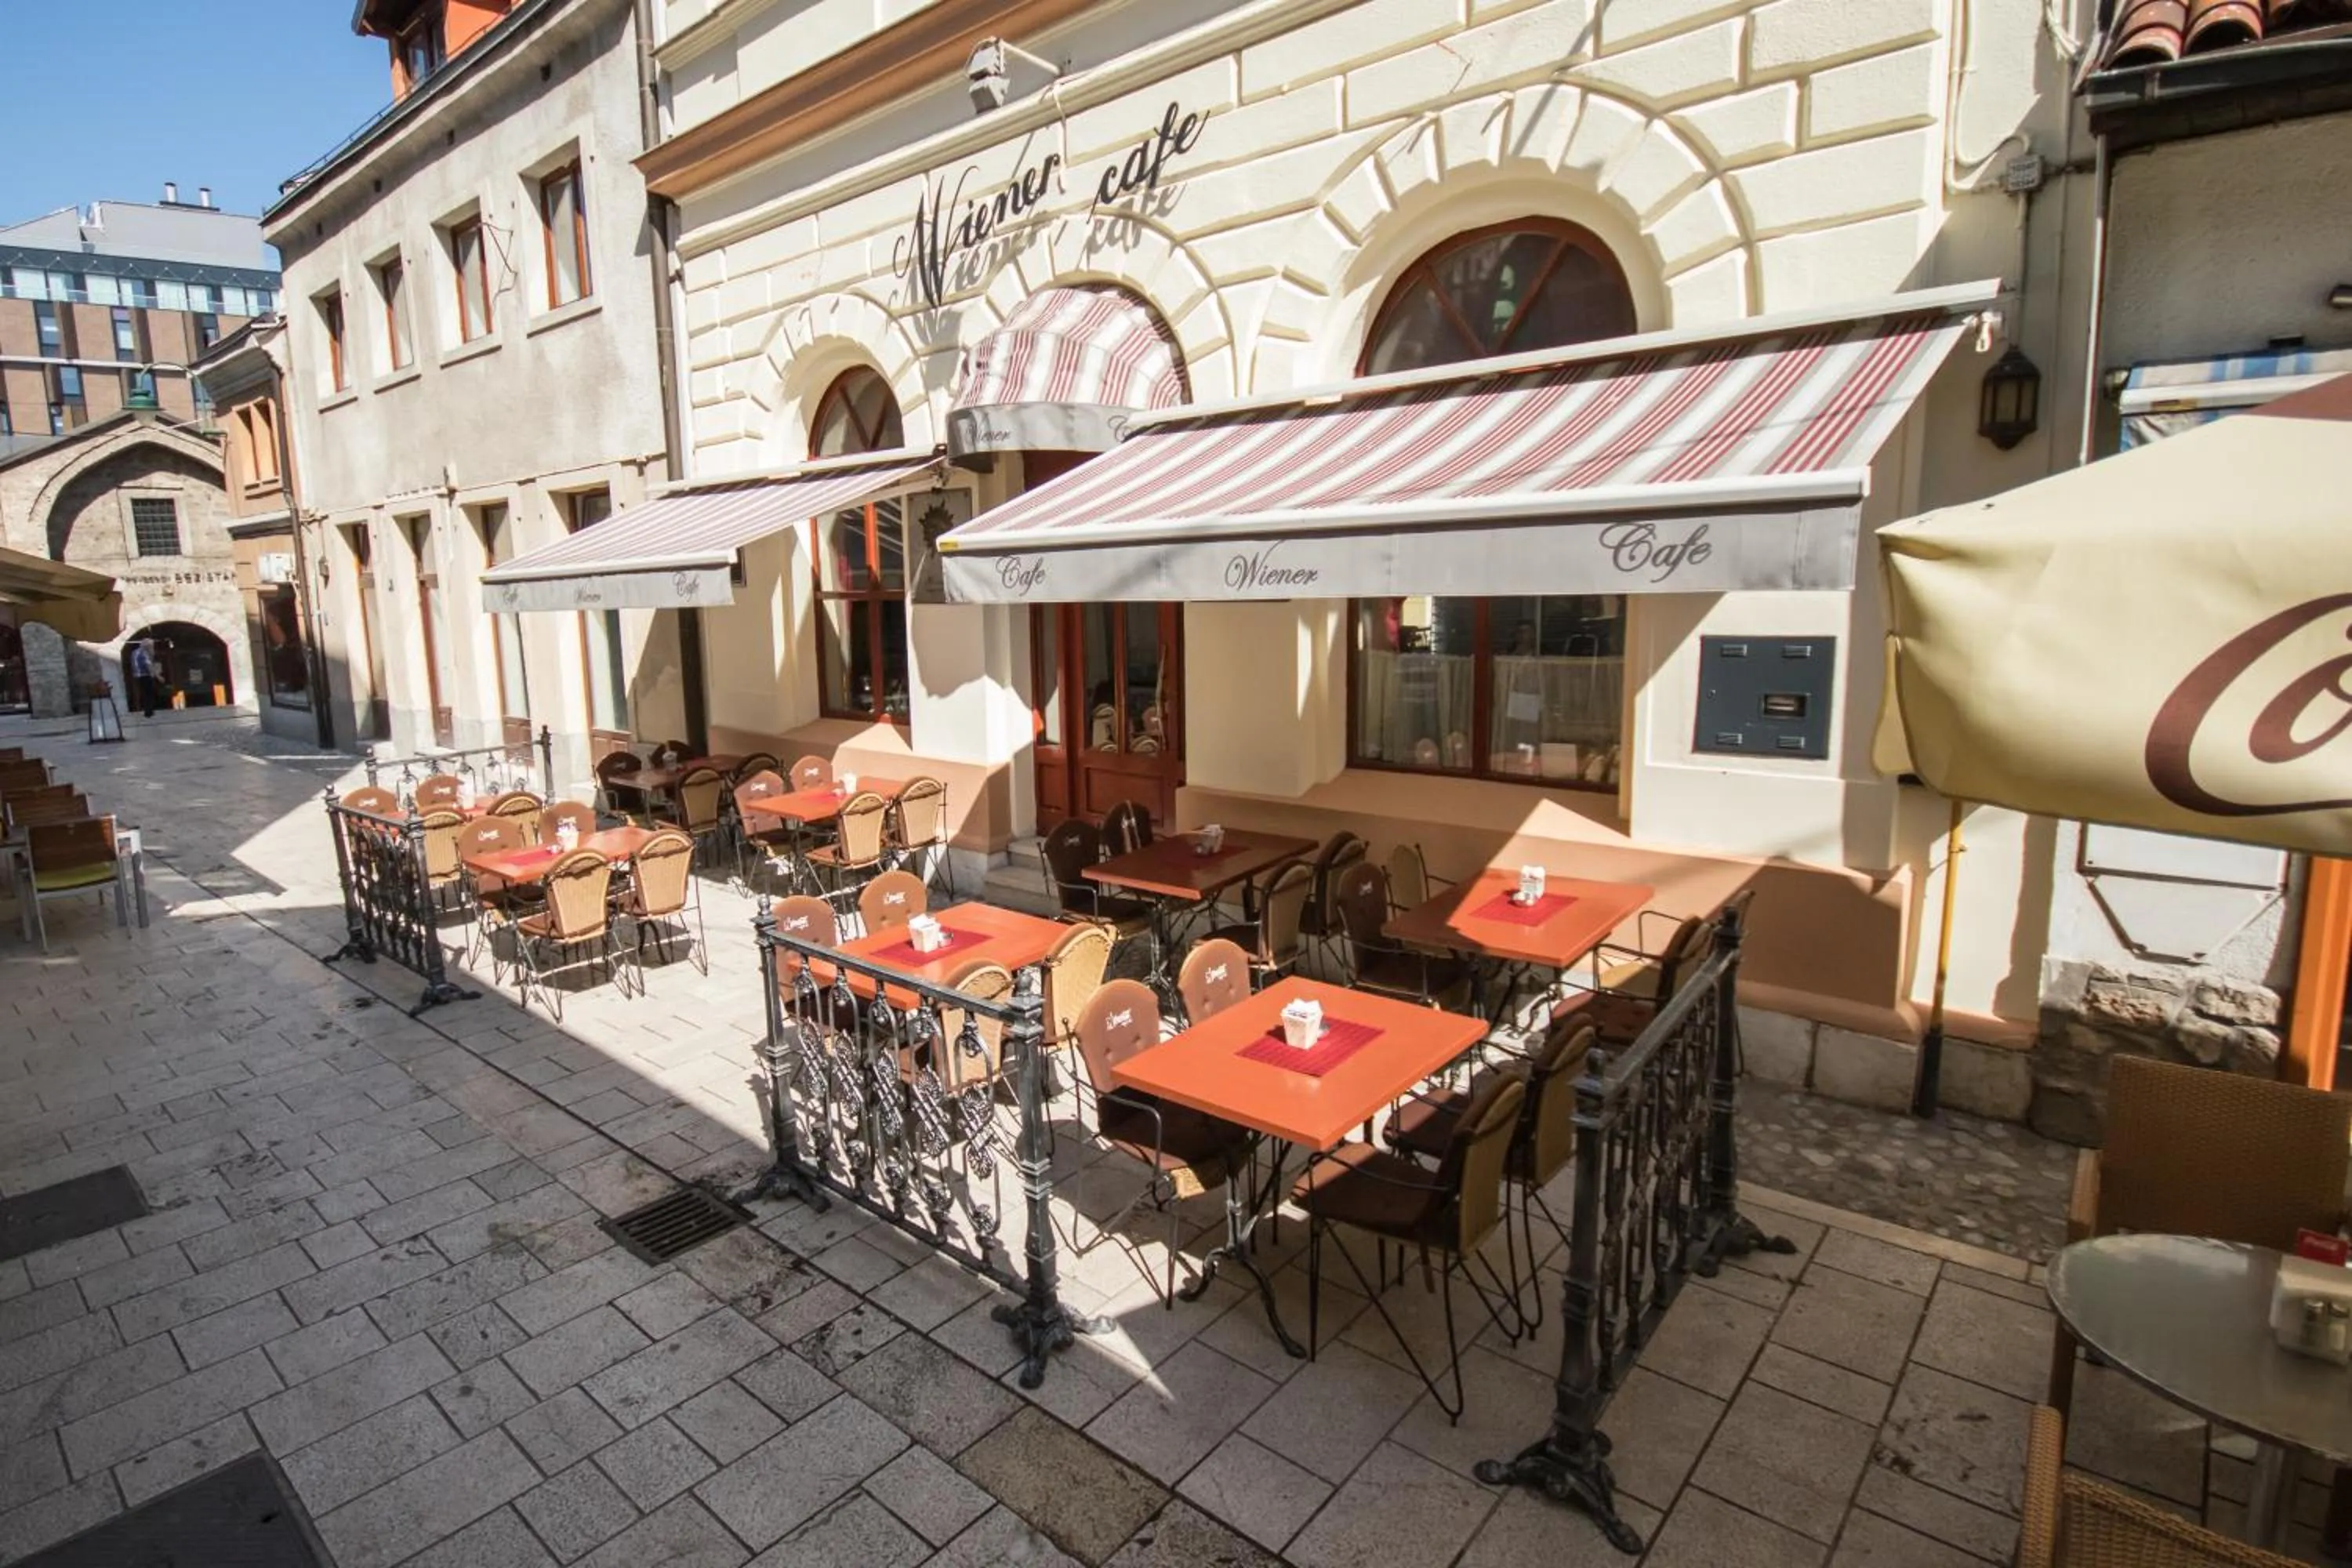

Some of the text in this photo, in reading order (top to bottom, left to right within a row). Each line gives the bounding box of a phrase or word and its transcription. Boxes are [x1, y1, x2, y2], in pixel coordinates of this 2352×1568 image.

[892, 100, 1210, 309] Wiener cafe
[673, 570, 700, 603] Cafe
[995, 522, 1712, 597] Cafe Wiener Cafe
